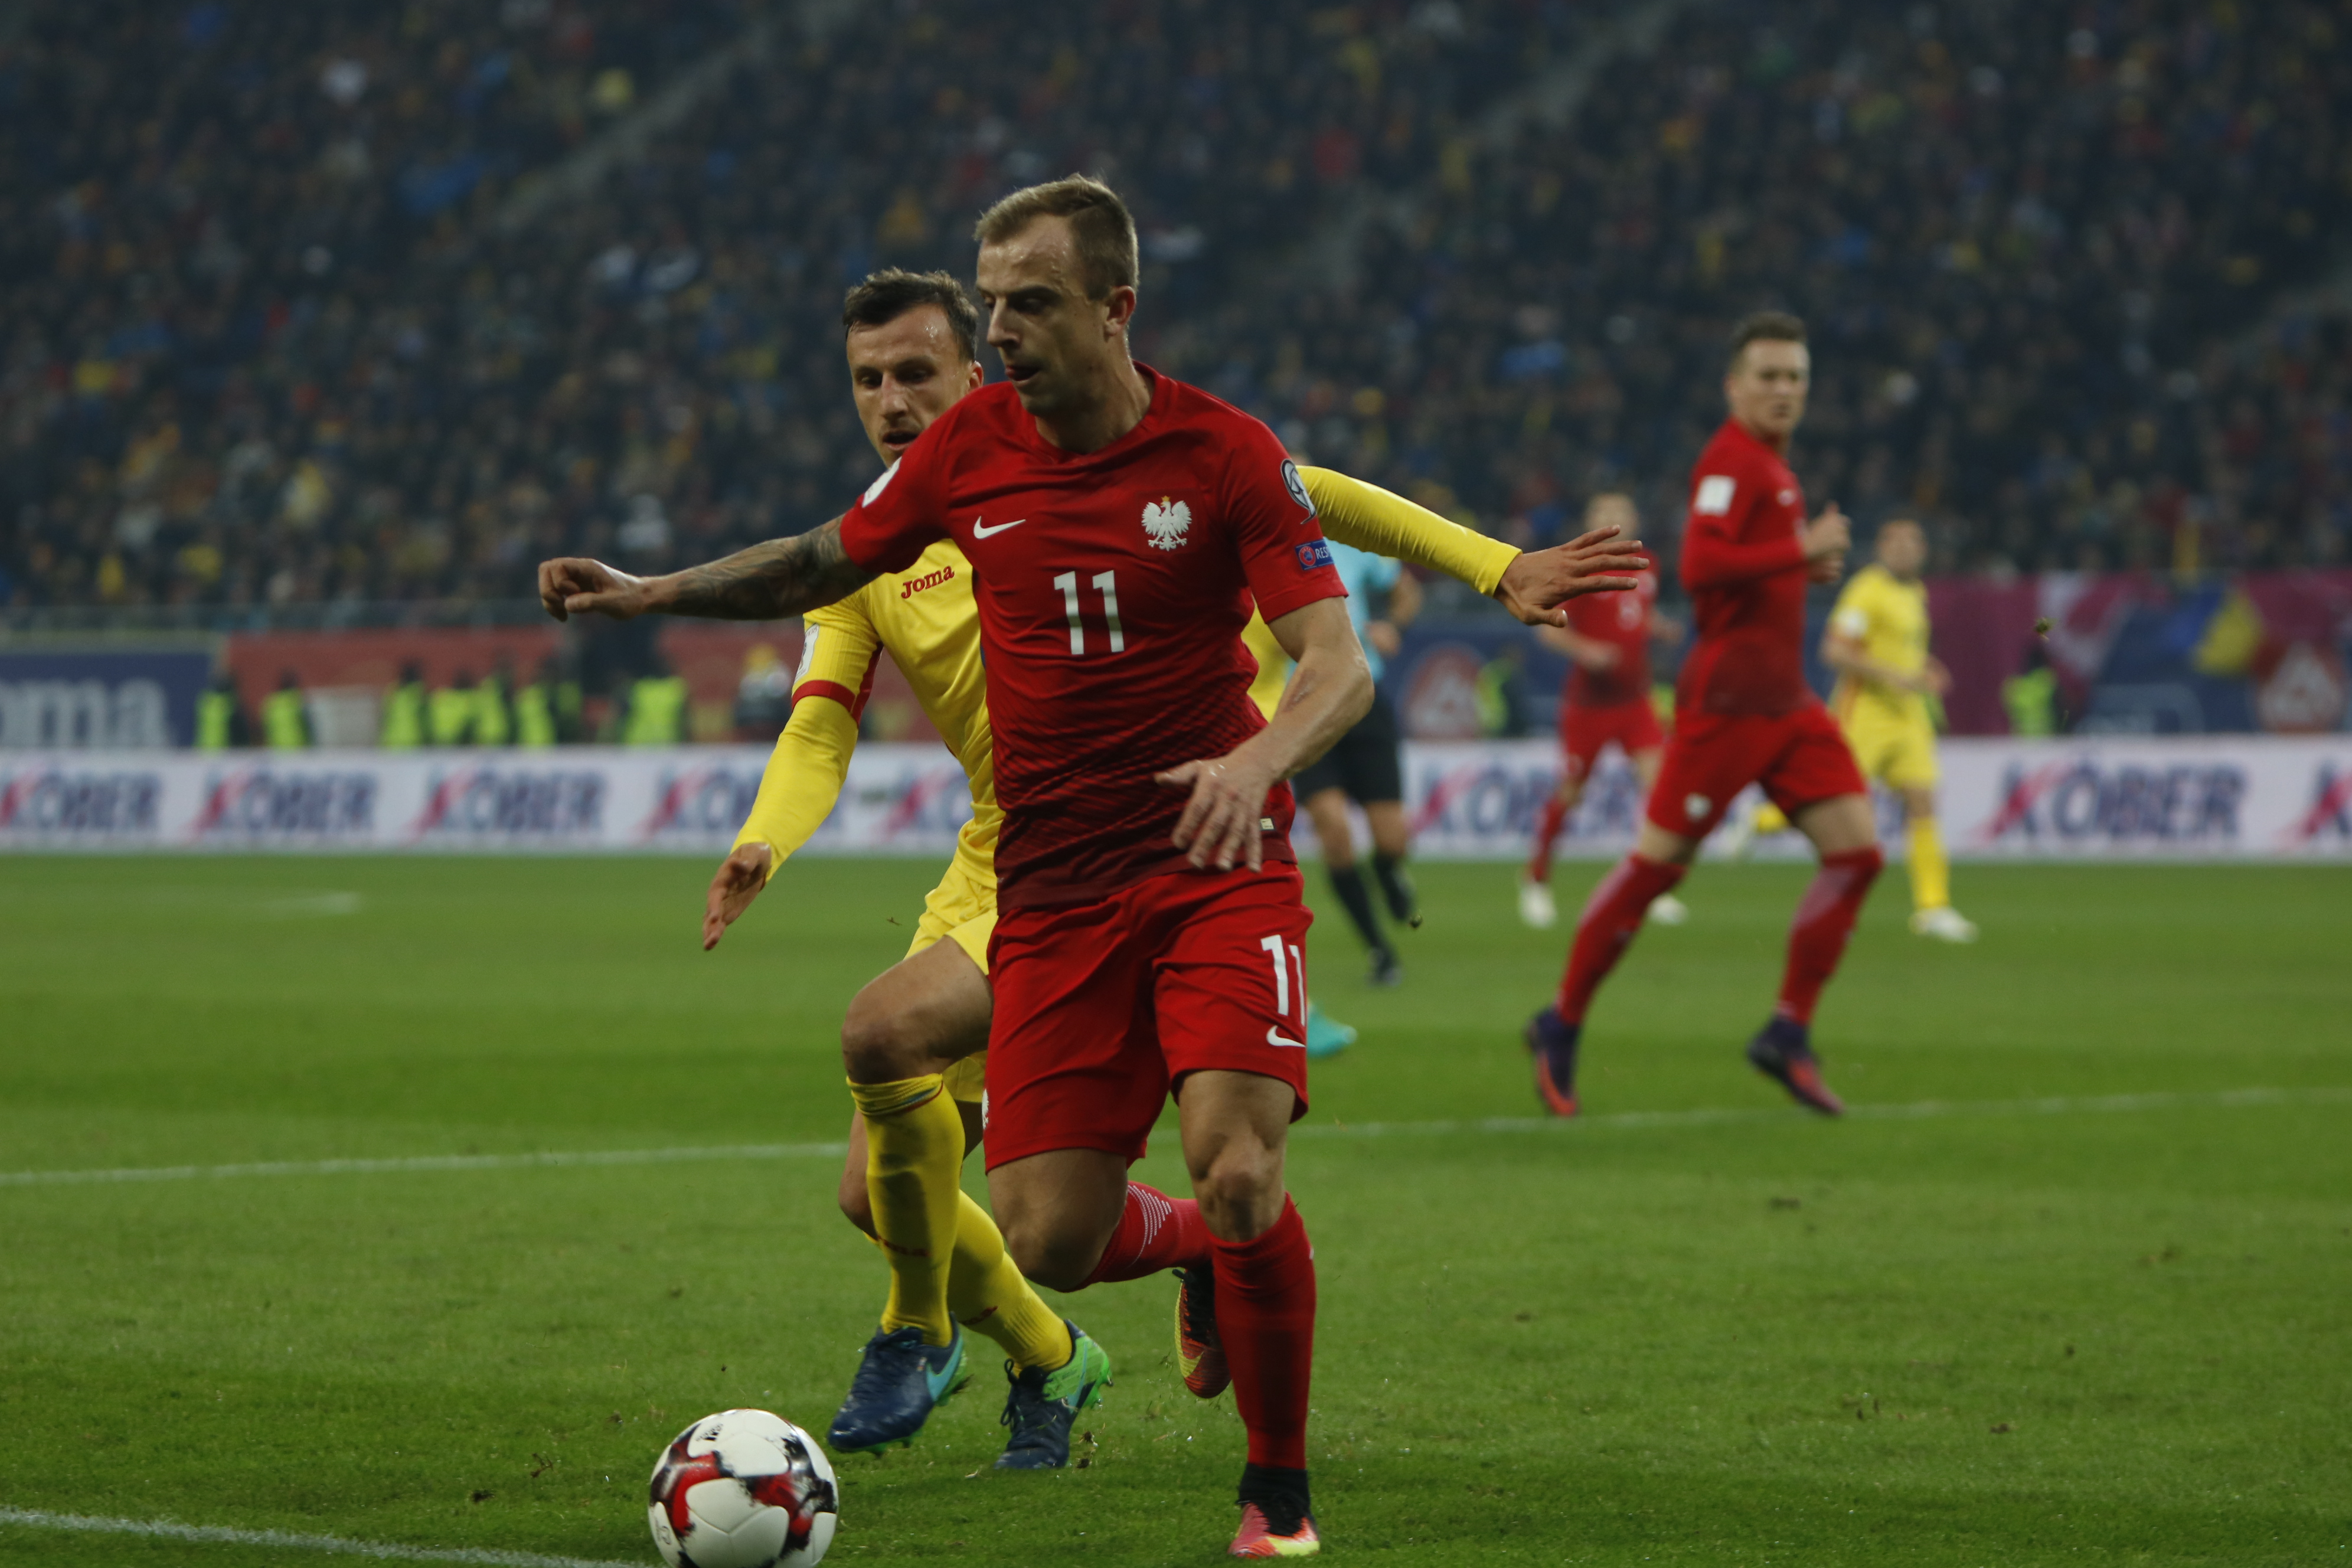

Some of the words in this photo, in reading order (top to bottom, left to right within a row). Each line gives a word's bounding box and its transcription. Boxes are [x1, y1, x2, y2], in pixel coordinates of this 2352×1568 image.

[901, 566, 955, 599] Joma
[1054, 570, 1125, 655] 11
[1260, 934, 1306, 1027] 11
